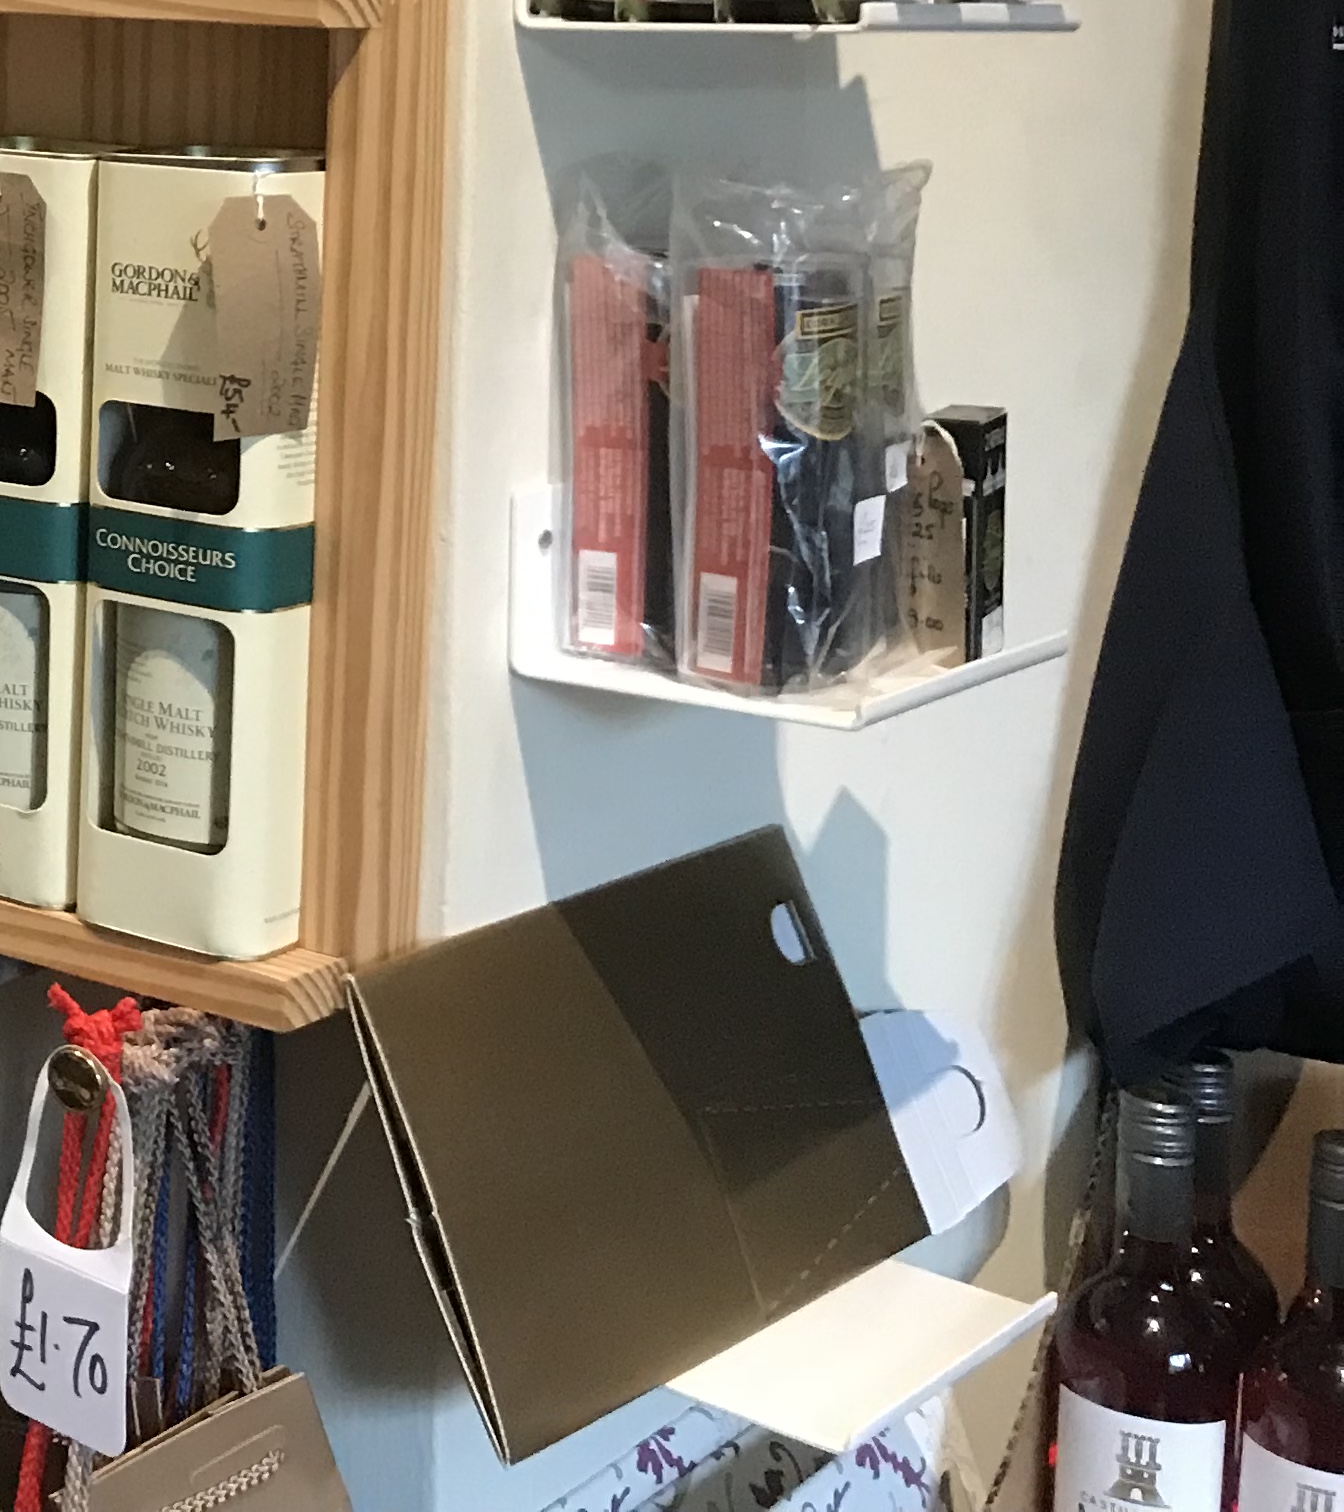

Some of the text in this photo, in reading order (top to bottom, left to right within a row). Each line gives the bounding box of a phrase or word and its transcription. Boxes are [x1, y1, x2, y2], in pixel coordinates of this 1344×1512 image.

[111, 277, 199, 303] MACPHAIL
[95, 527, 237, 570] CONNOISSEURS
[127, 552, 197, 583] CHOICE
[158, 701, 203, 722] MALT
[154, 715, 217, 739] WHISKY
[136, 758, 167, 777] 2002
[9, 1267, 110, 1398] £1.70
